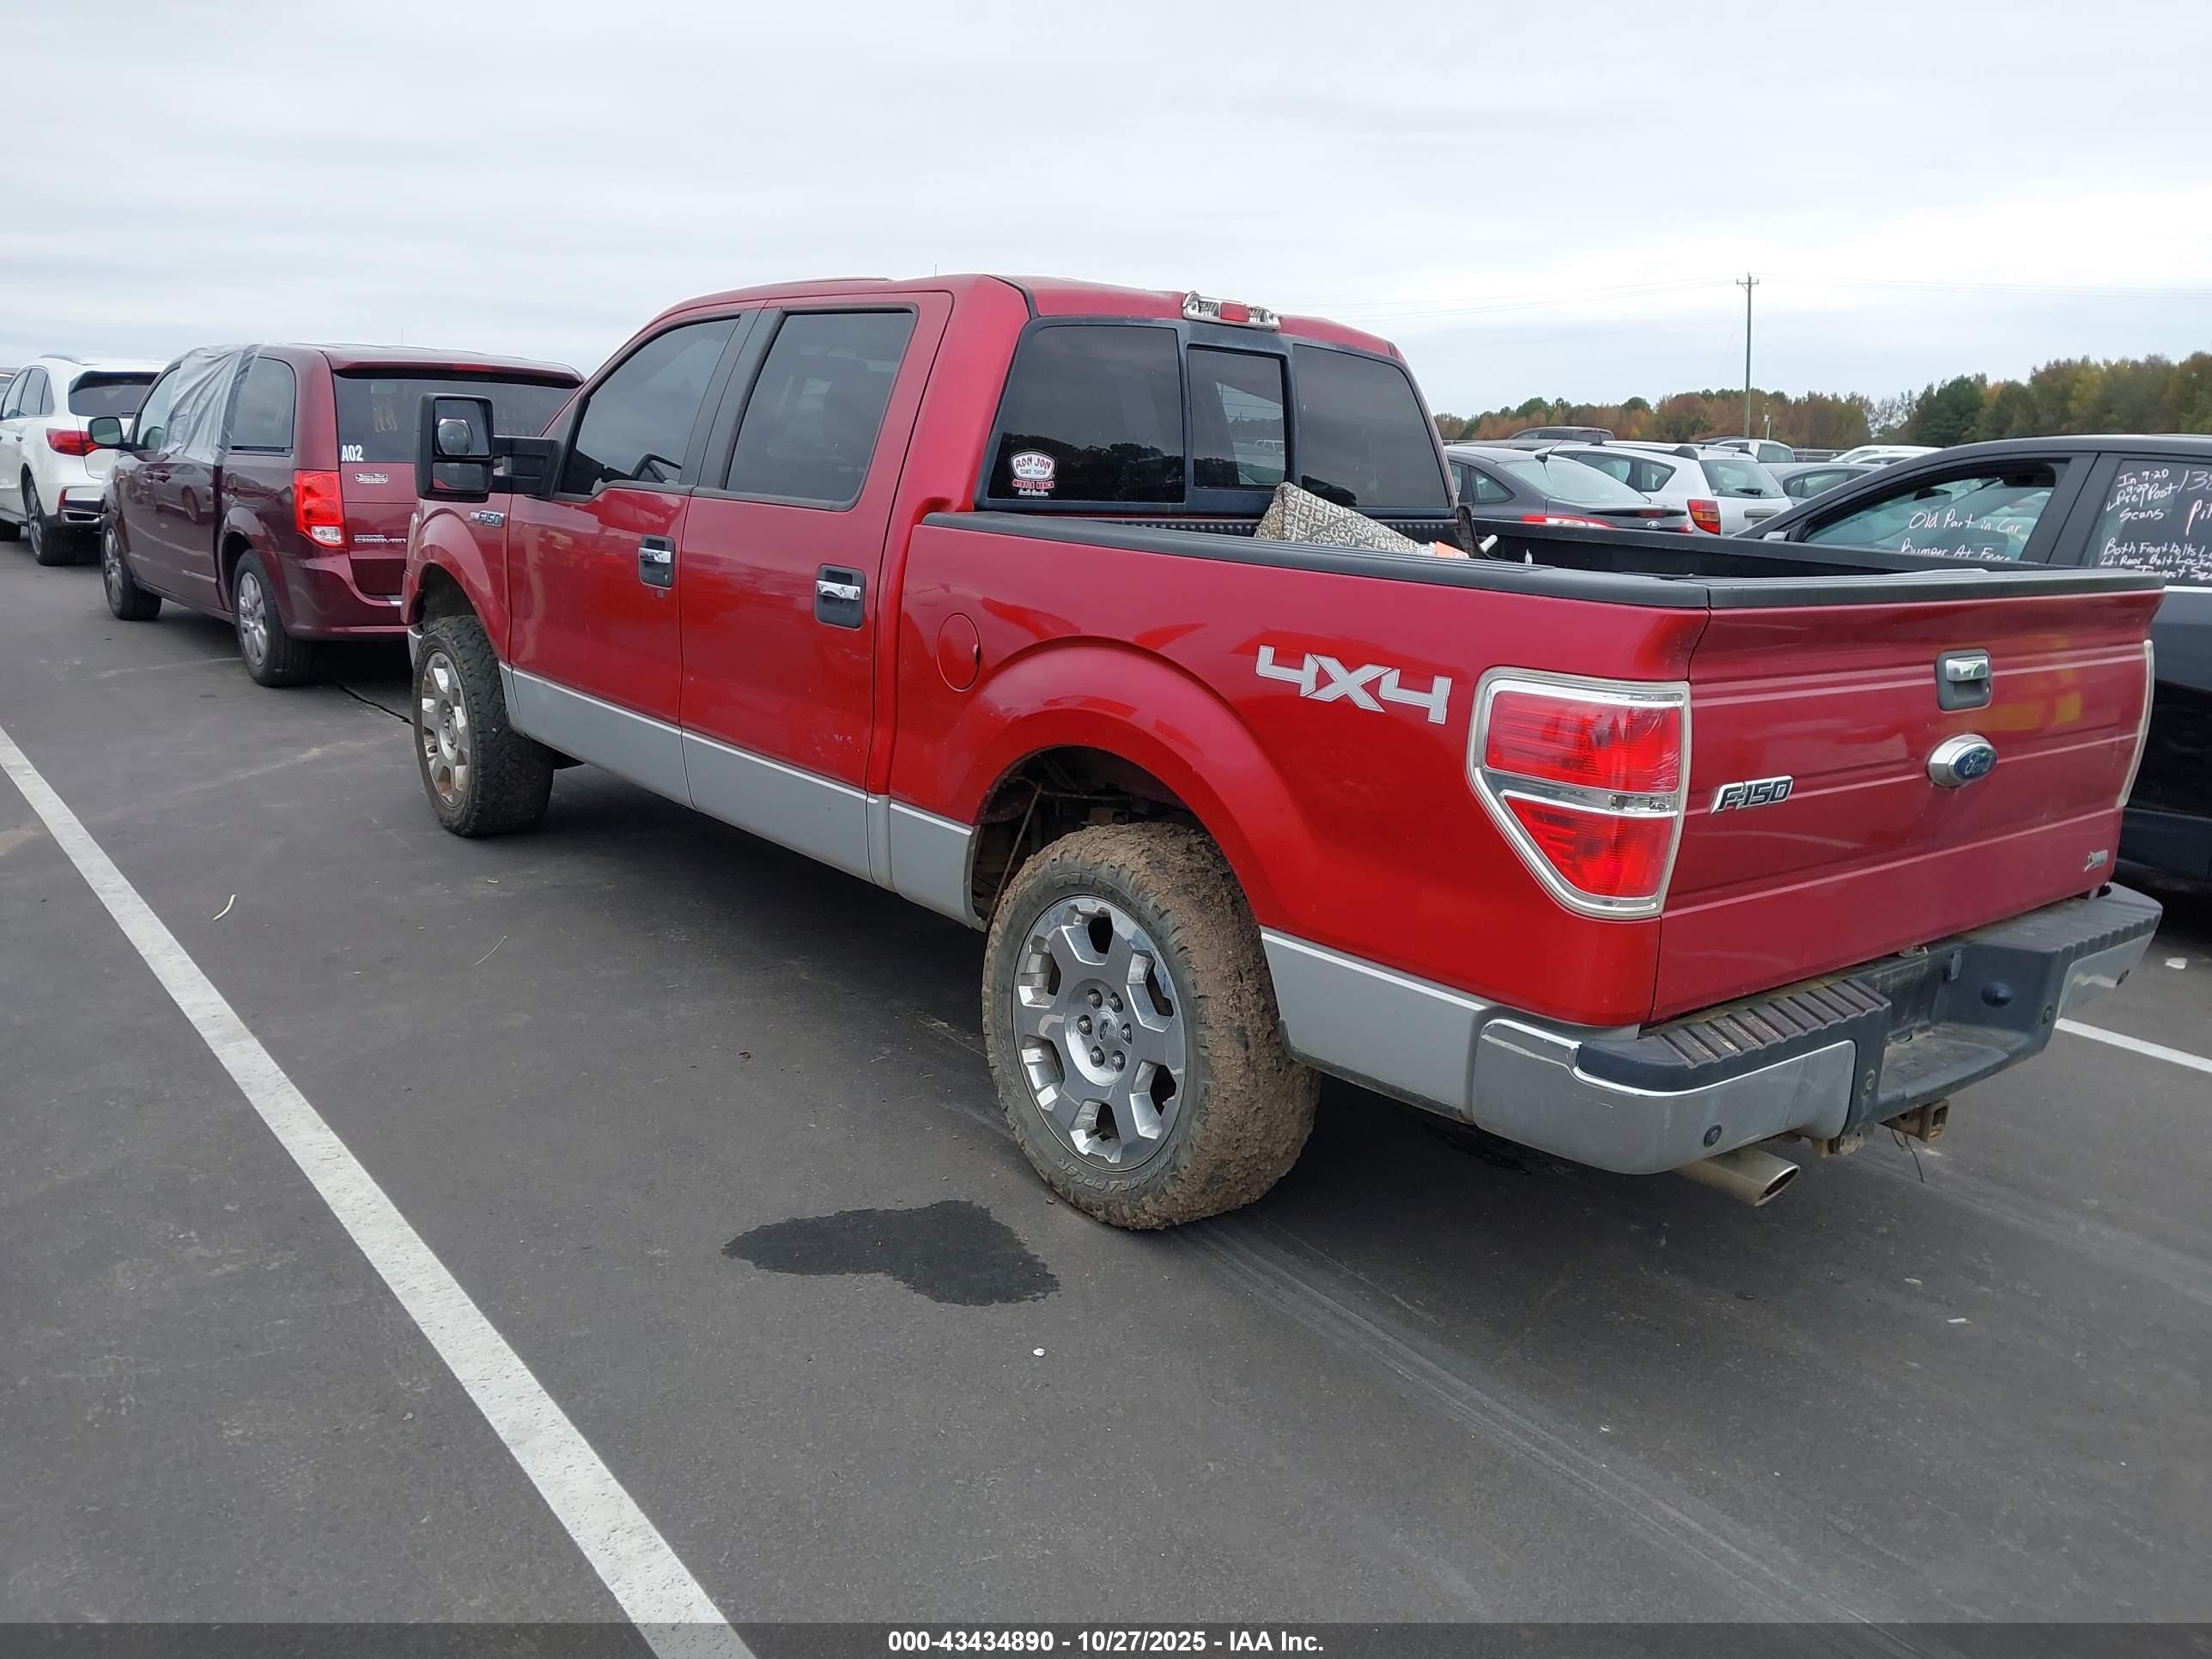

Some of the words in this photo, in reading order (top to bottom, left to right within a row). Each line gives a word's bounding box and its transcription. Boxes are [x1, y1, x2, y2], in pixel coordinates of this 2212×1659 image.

[341, 444, 363, 462] A02
[1016, 456, 1032, 470] RON
[1035, 458, 1051, 471] JON
[1909, 511, 1939, 530] Old
[1943, 508, 1976, 529] Part
[1980, 520, 1992, 532] in
[1996, 517, 2023, 533] Car
[2103, 538, 2136, 556] Both
[1710, 775, 1795, 815] F-150
